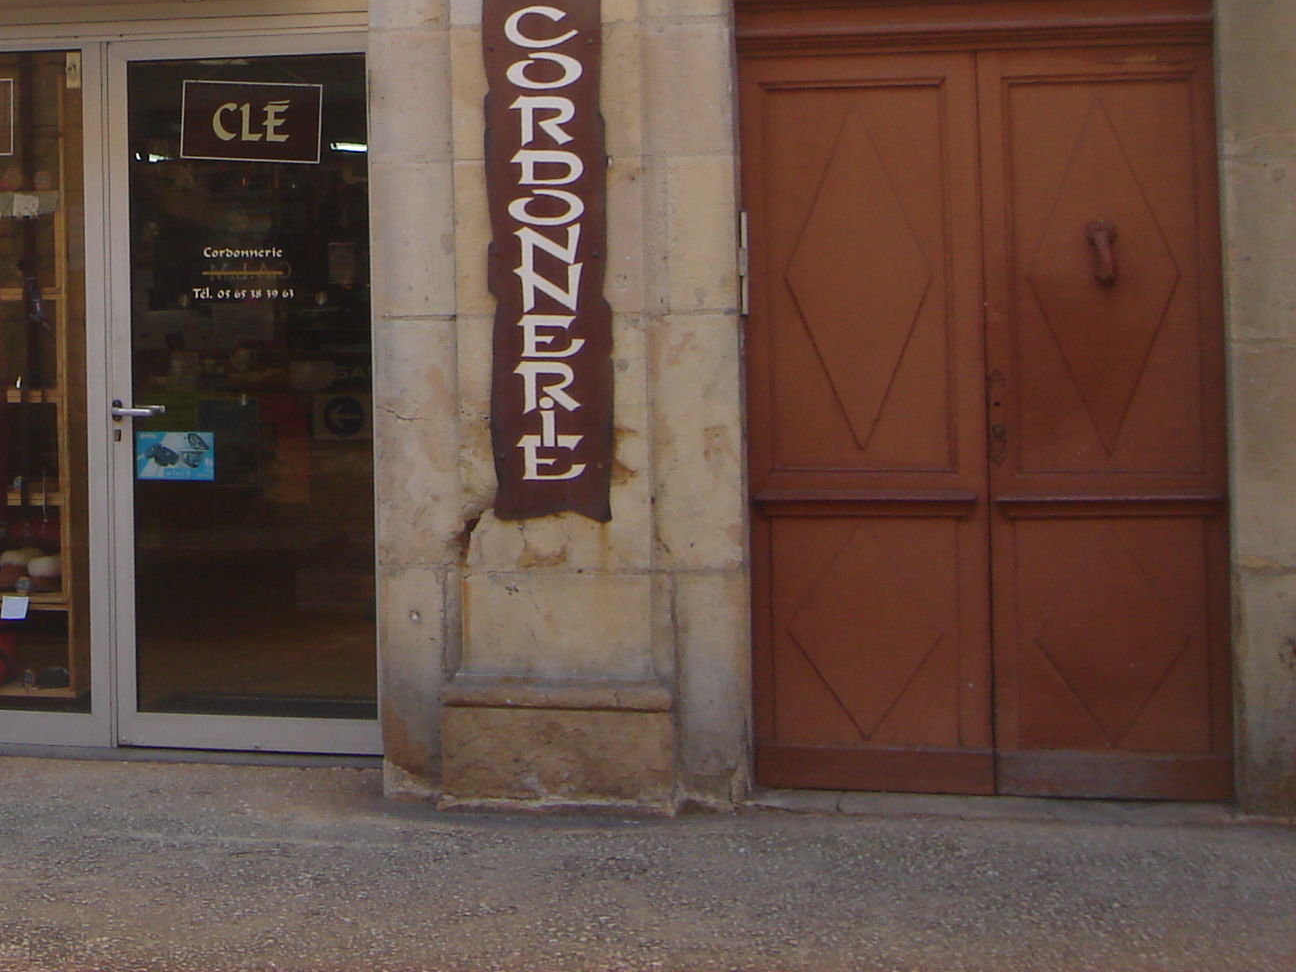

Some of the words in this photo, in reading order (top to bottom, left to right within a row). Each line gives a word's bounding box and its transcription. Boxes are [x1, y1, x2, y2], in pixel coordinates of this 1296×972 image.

[212, 99, 291, 142] CLÉ
[203, 247, 283, 258] Cordonnerie
[192, 287, 213, 299] Tél.
[217, 289, 231, 299] 05
[234, 289, 247, 299] 65
[250, 289, 262, 299] 38
[266, 289, 279, 299] 39
[281, 289, 294, 299] 63
